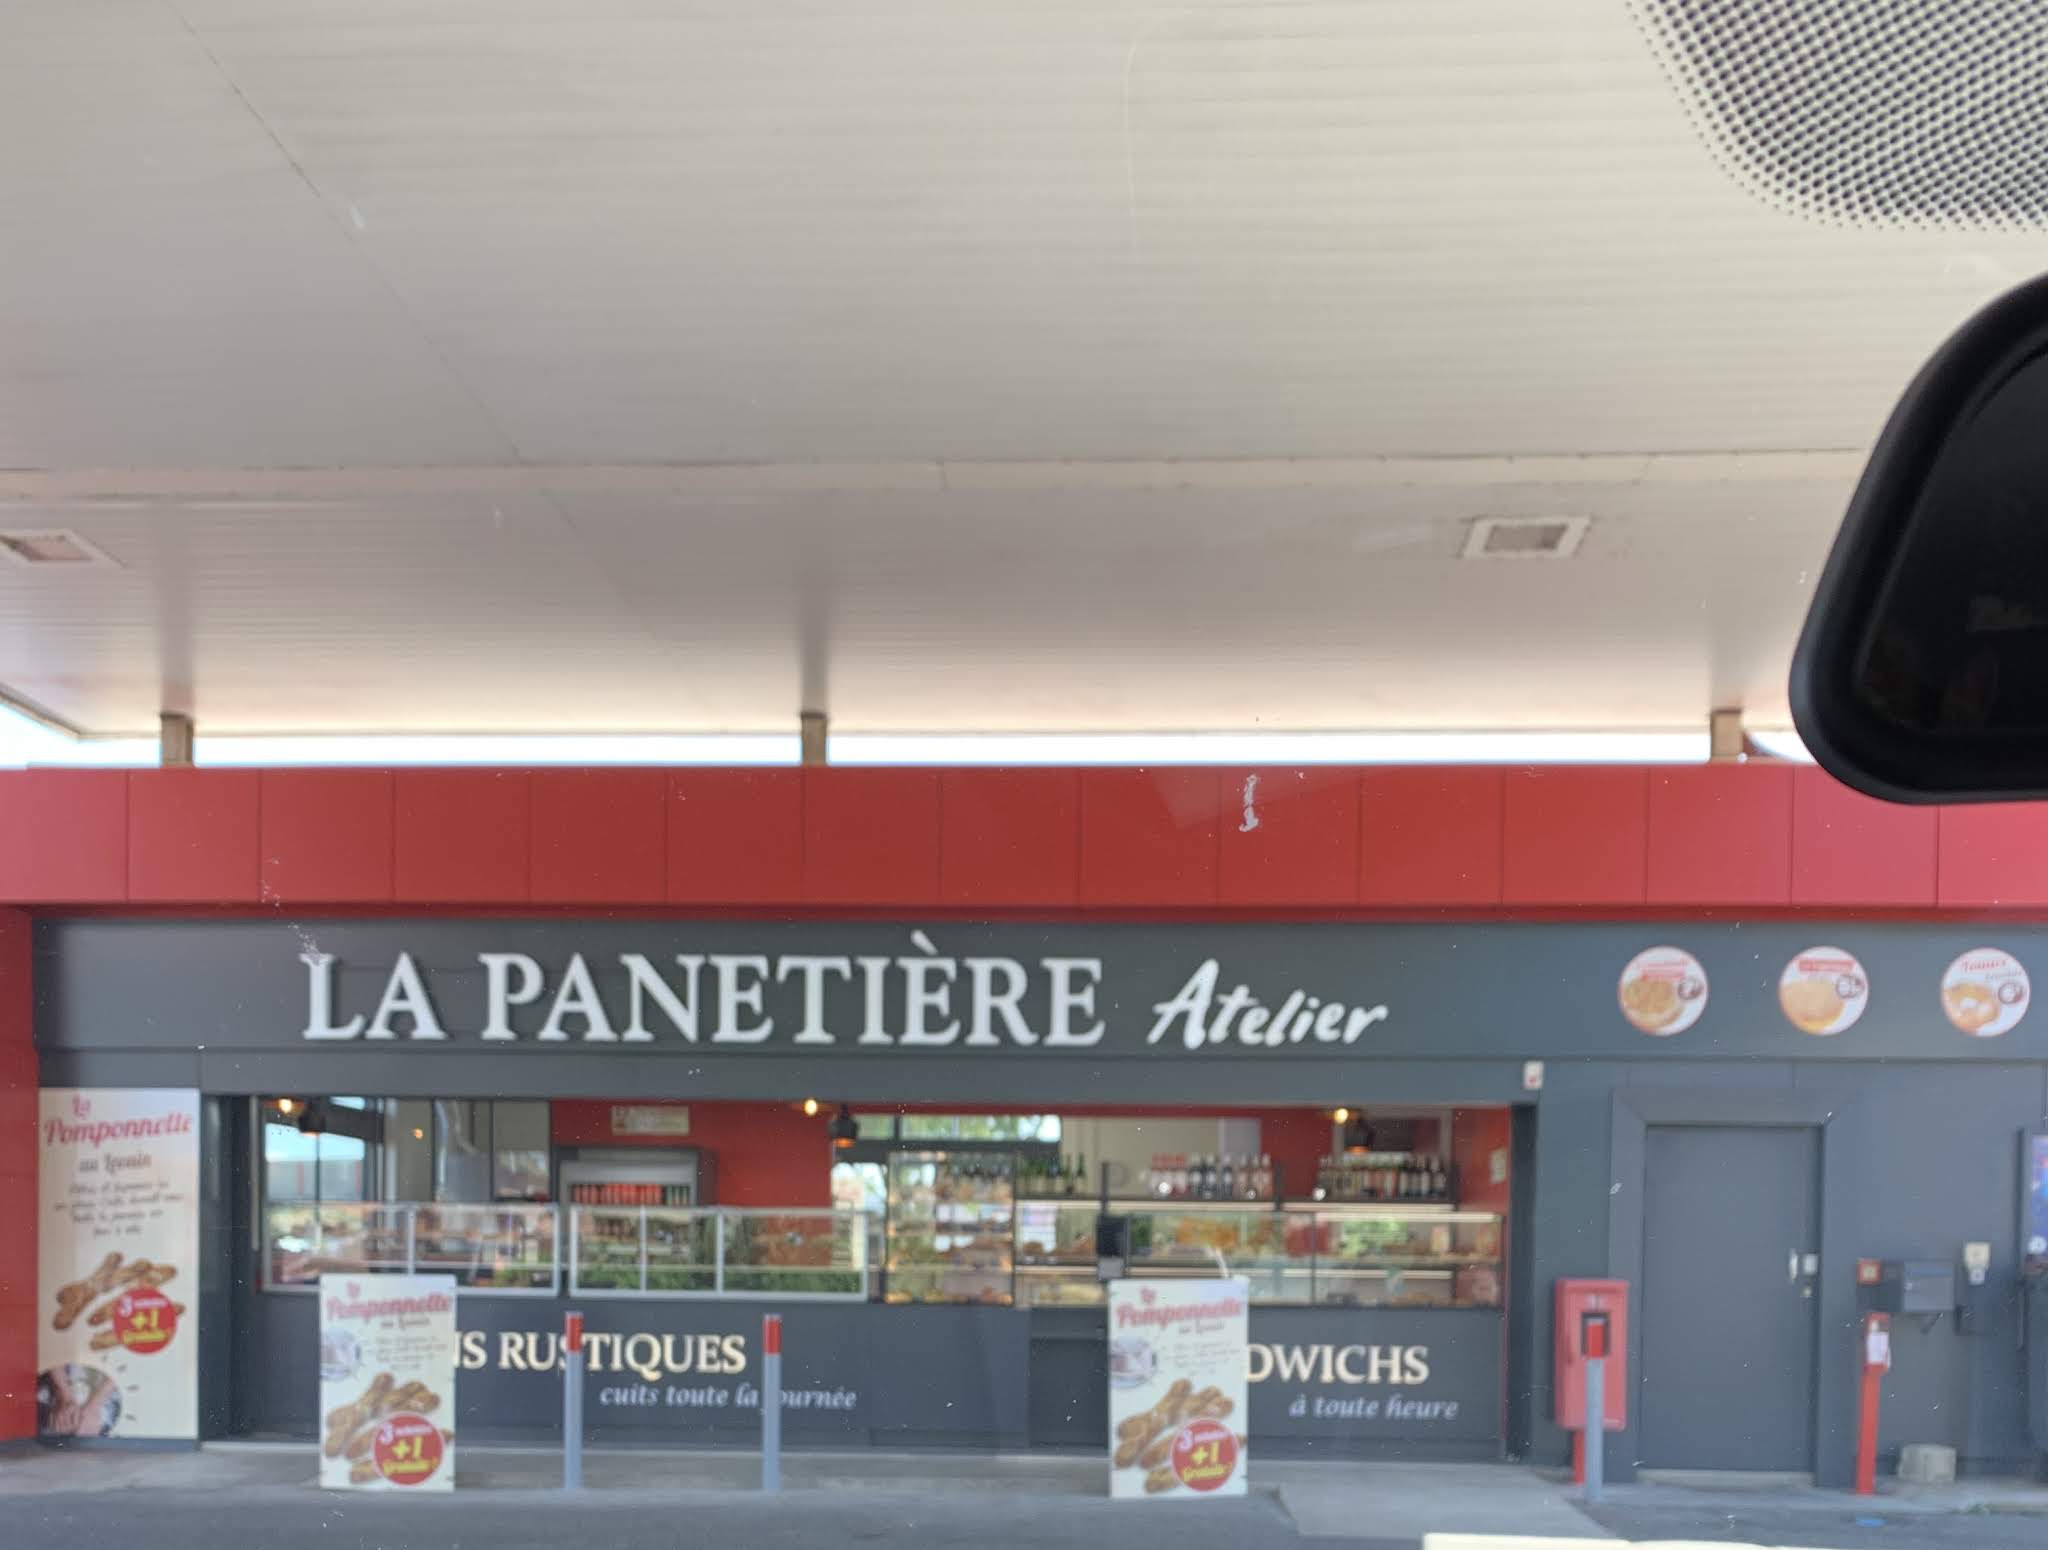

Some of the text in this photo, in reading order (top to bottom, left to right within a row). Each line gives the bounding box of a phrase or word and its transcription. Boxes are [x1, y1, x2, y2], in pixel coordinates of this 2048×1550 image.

[300, 930, 1389, 1049] LA PANETIÈRE Atelier
[129, 1308, 160, 1330] +1
[600, 1381, 857, 1412] cuits toute la ournée
[1289, 1393, 1459, 1419] à toute heure
[391, 1436, 422, 1460] +1
[1178, 1429, 1192, 1451] 3
[1190, 1440, 1219, 1465] +1
